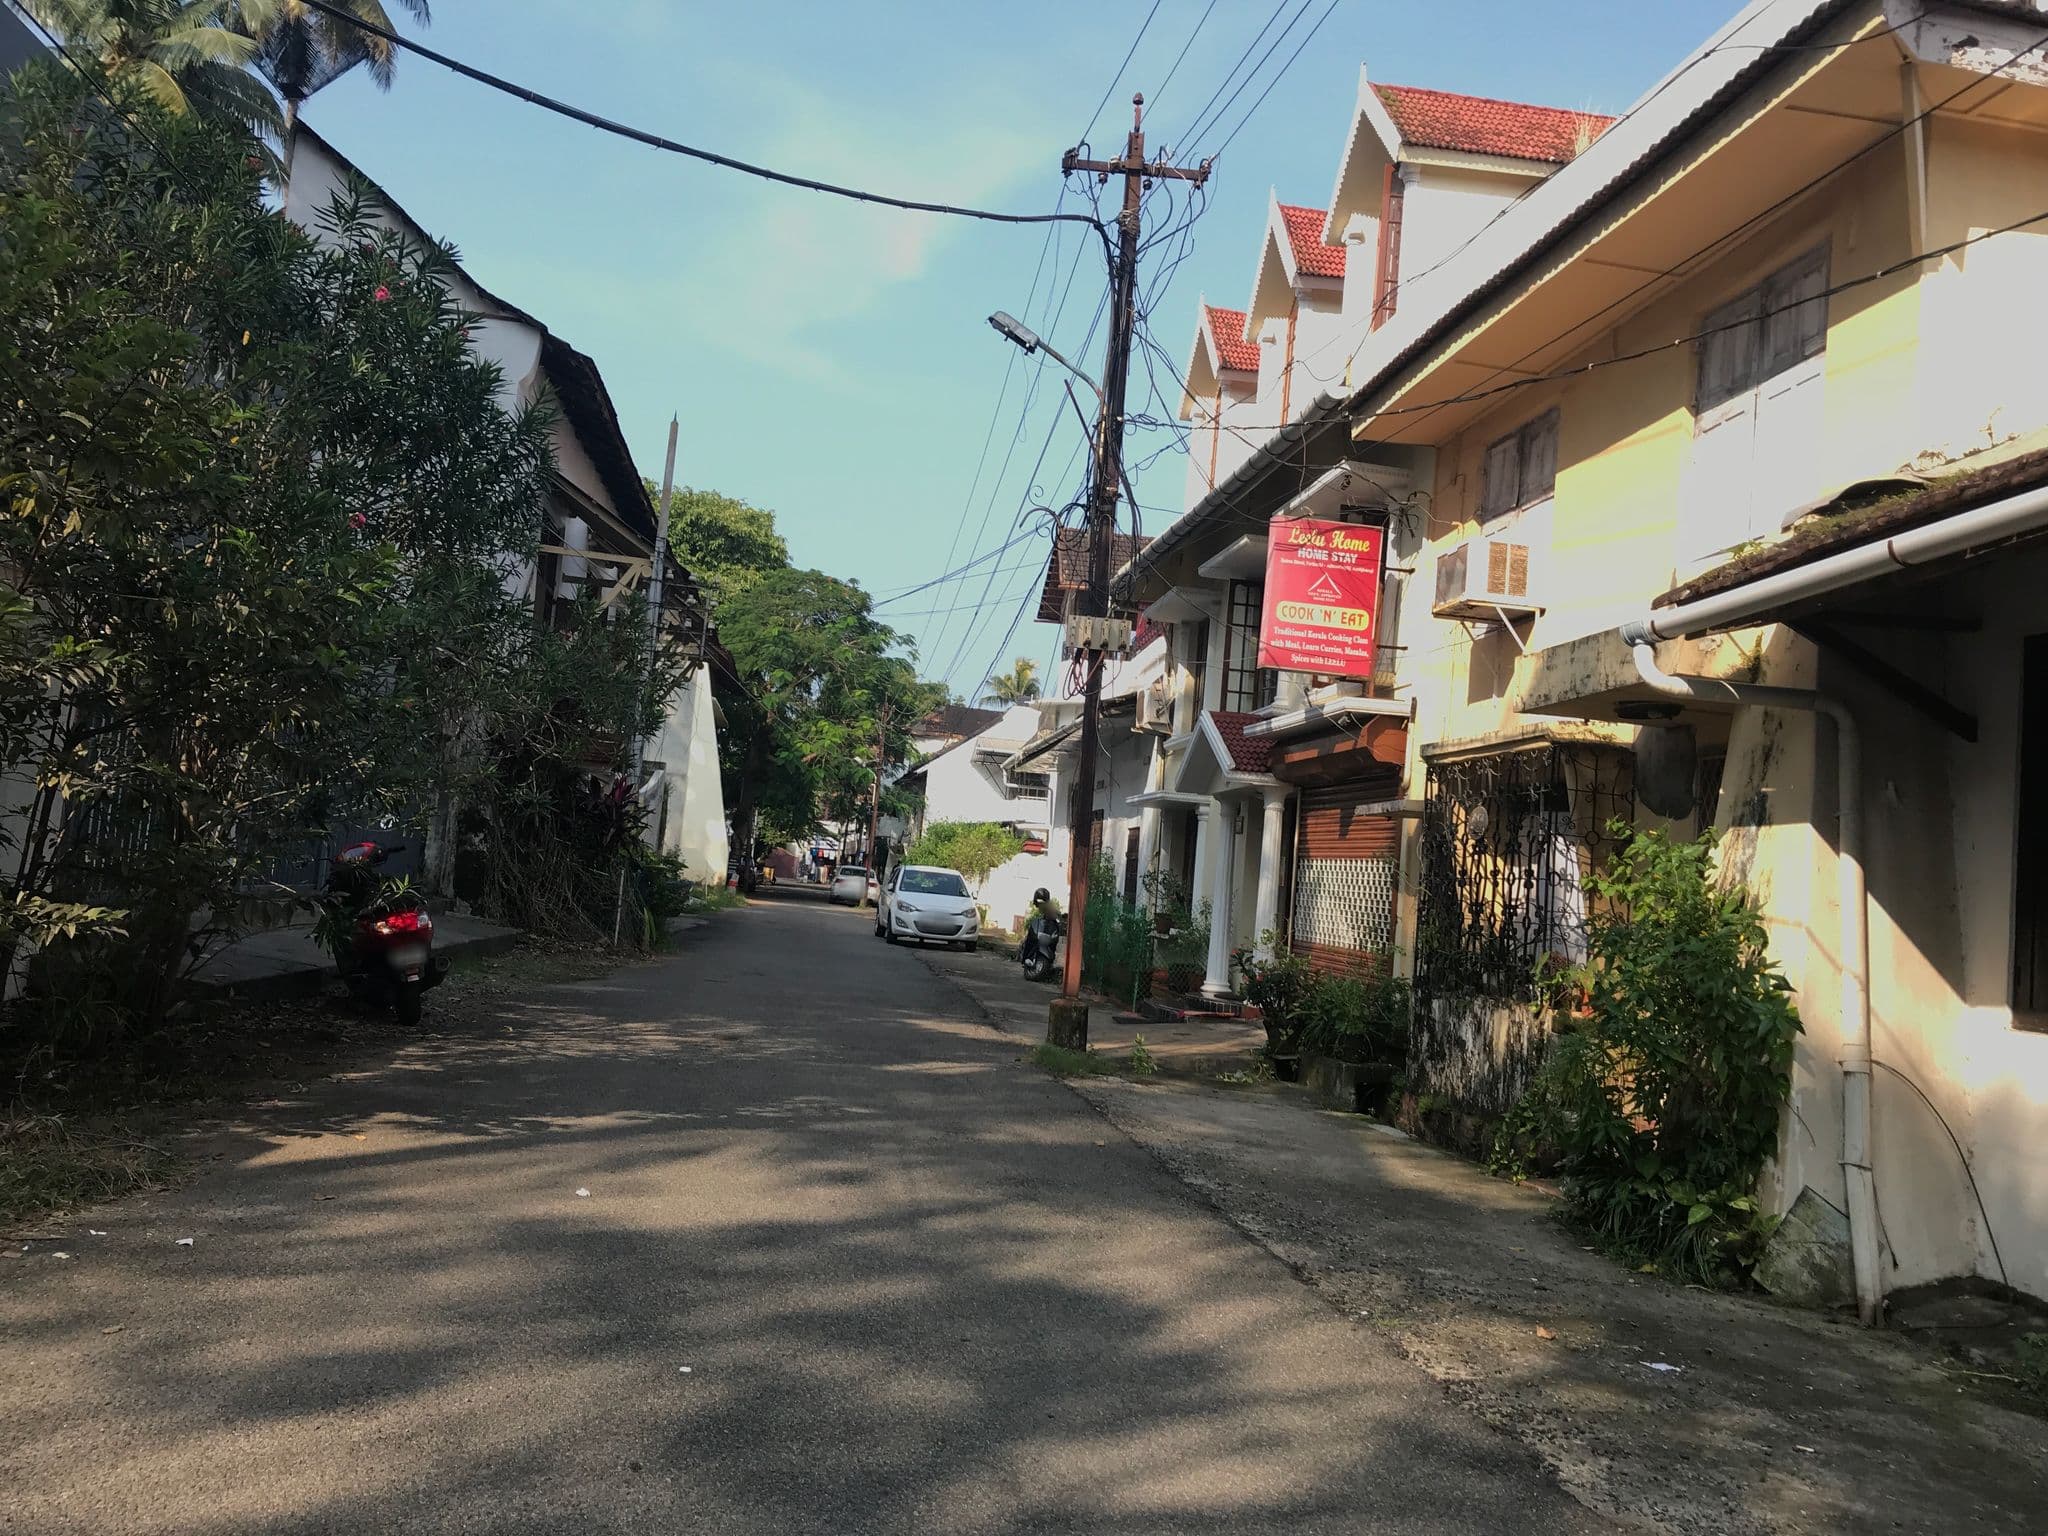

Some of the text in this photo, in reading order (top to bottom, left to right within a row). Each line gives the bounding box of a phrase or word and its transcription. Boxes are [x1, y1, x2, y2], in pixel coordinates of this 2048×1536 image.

[1330, 530, 1370, 552] Home
[1298, 547, 1329, 560] HOME
[1331, 551, 1358, 564] STAY
[1281, 605, 1314, 621] COOK
[1341, 611, 1365, 626] EAT
[1273, 626, 1307, 637] Traditional
[1307, 630, 1327, 640] Kerala
[1328, 633, 1352, 645] Cooking
[1302, 642, 1320, 652] Learn
[1290, 653, 1310, 664] Spices
[1310, 656, 1324, 665] with
